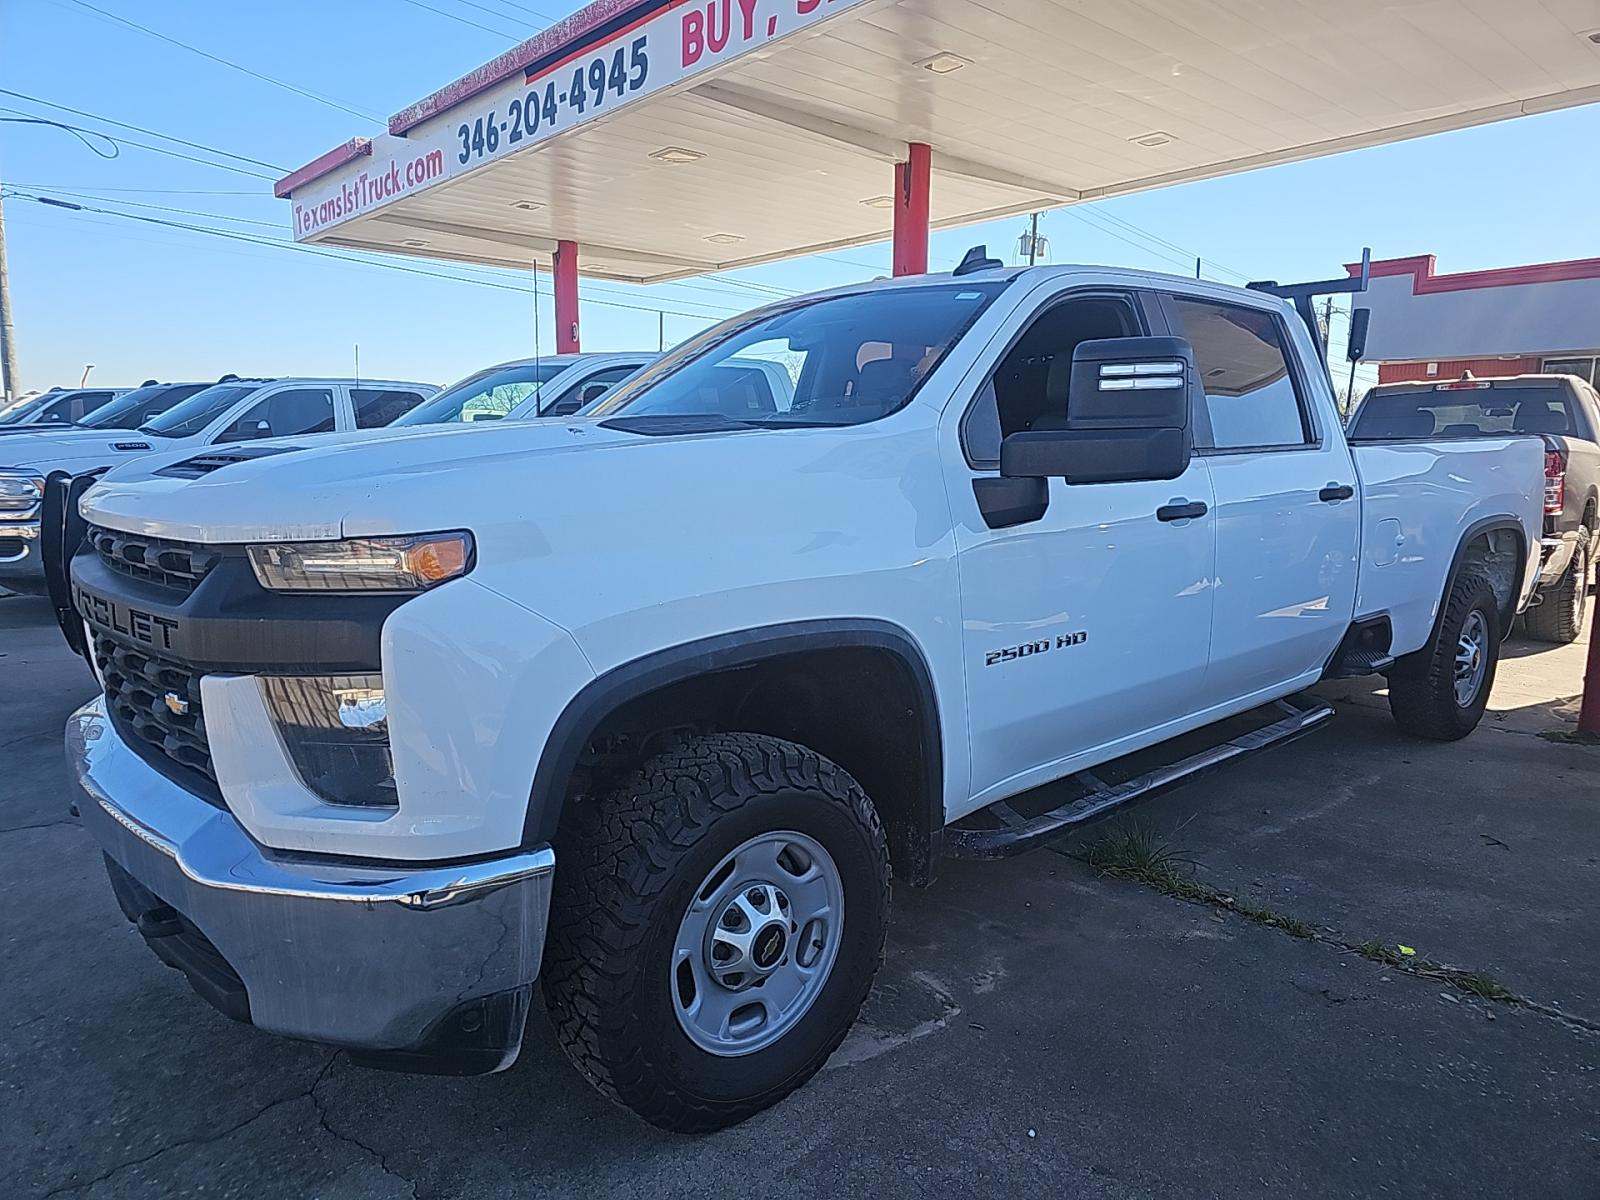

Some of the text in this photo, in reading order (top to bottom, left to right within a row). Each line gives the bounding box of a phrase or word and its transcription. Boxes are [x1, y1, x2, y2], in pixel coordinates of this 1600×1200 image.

[681, 0, 778, 68] BUY,
[457, 34, 649, 165] 346-204-4945
[985, 630, 1088, 667] 2500 HD
